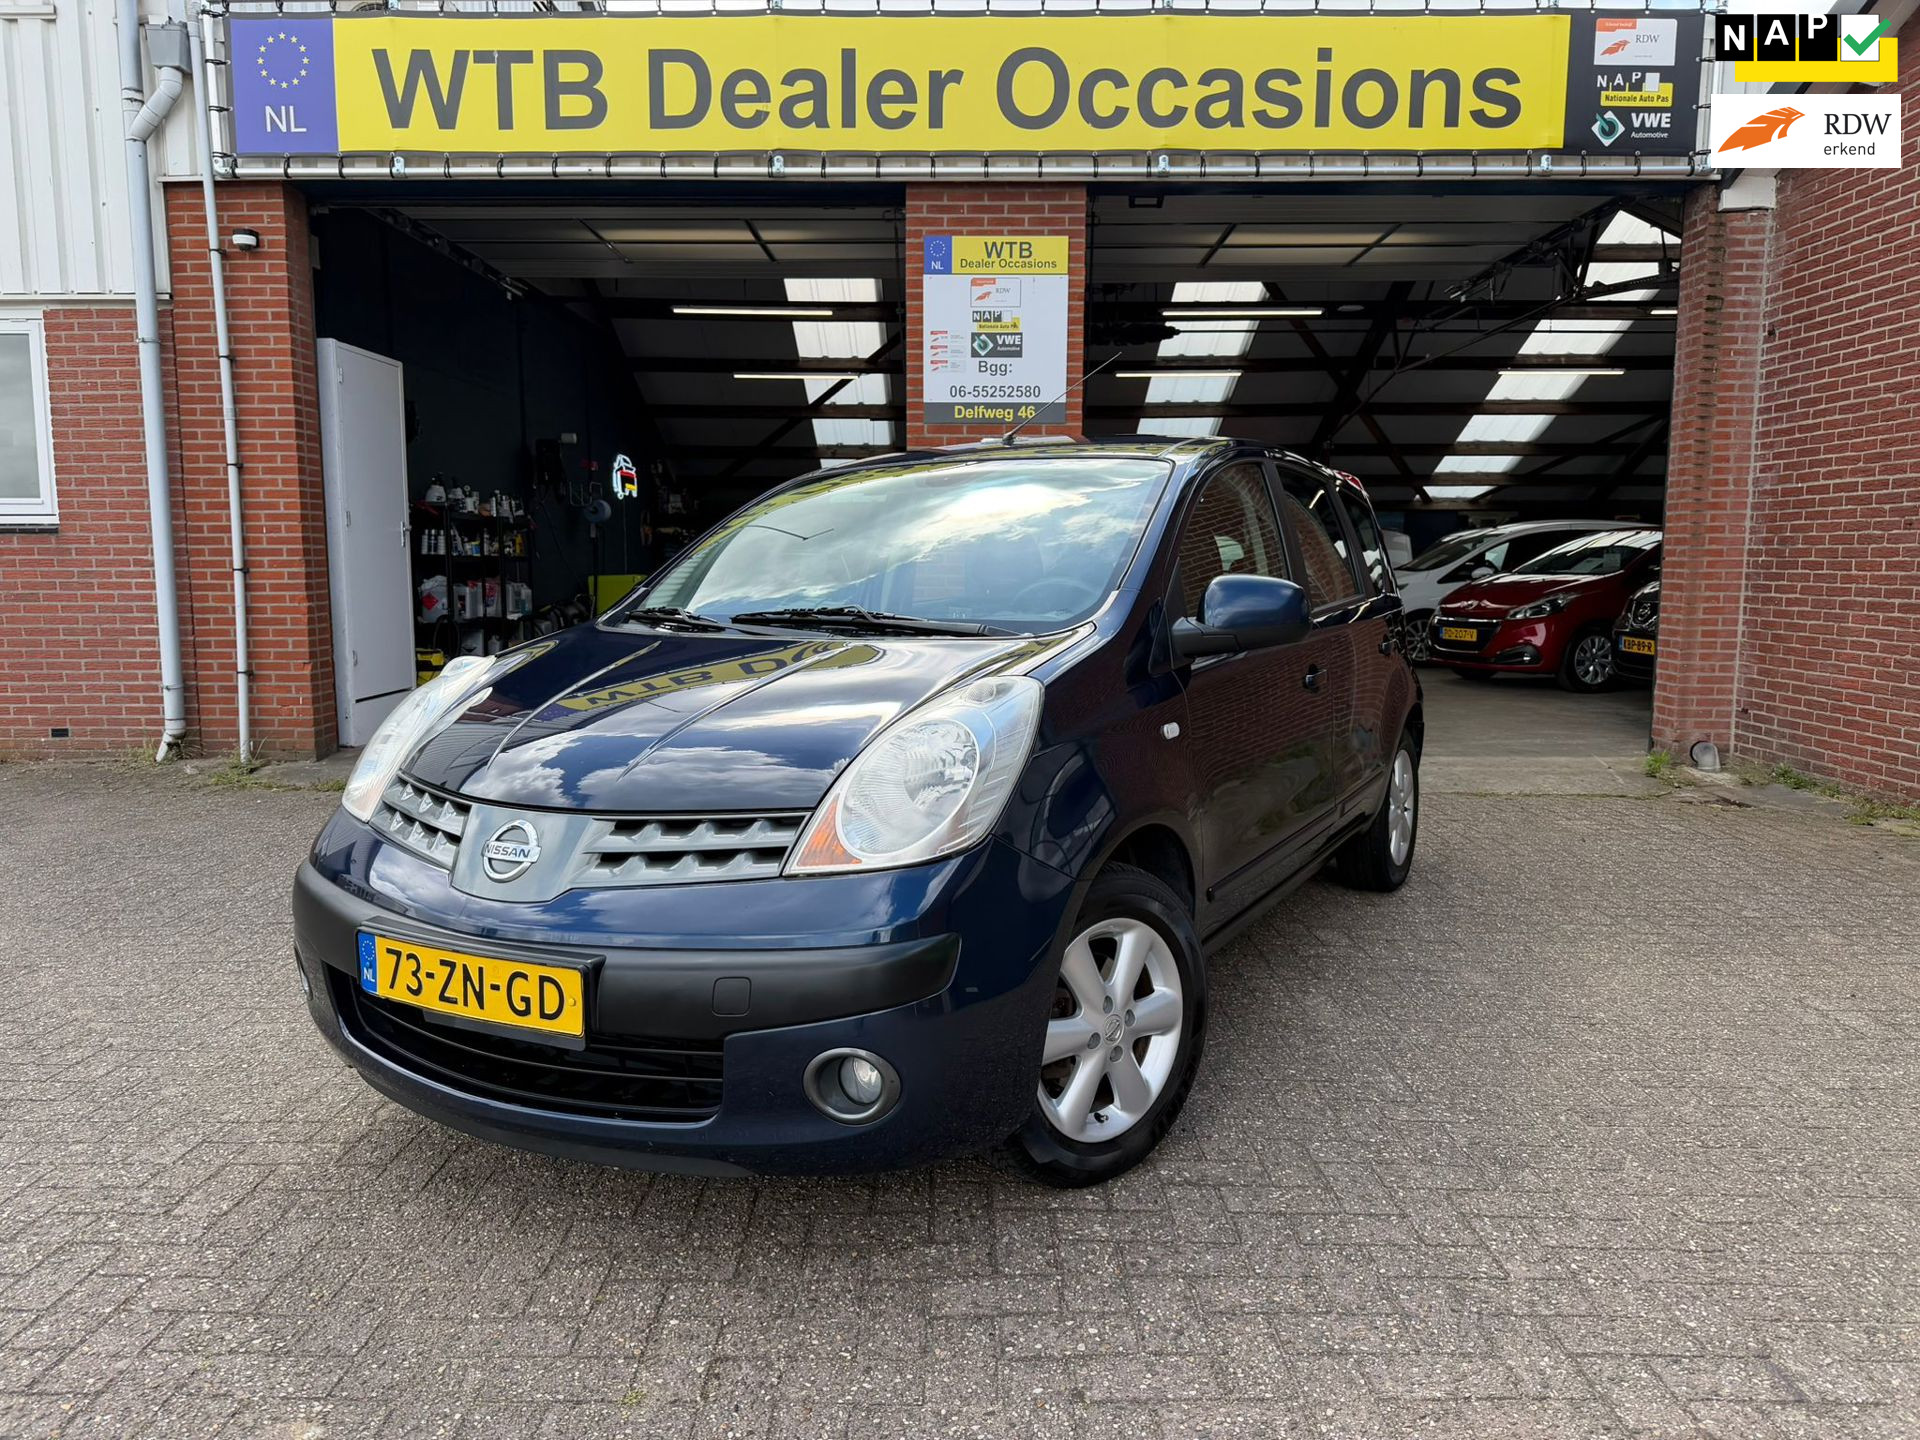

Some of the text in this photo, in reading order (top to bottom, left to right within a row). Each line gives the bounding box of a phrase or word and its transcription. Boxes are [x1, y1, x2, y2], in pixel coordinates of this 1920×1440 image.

[1635, 34, 1660, 44] RDW
[1596, 71, 1642, 88] NAP
[371, 46, 1523, 131] WTB Dealer Occasions
[1604, 94, 1670, 103] Nationale Auto Pas
[265, 105, 307, 134] NL
[1630, 112, 1672, 129] VWE
[1630, 131, 1669, 140] Automotive
[984, 241, 1033, 259] WTB
[931, 262, 944, 270] NL
[960, 258, 1057, 269] Dealer Occasions
[996, 334, 1022, 345] VWE
[978, 360, 1013, 376] Bgg:
[949, 385, 1041, 398] 06-55252580
[954, 406, 1036, 421] Delfweg 46
[485, 844, 531, 858] NISSAN
[363, 967, 376, 983] NL
[385, 947, 565, 1021] 73-ZN-GD
